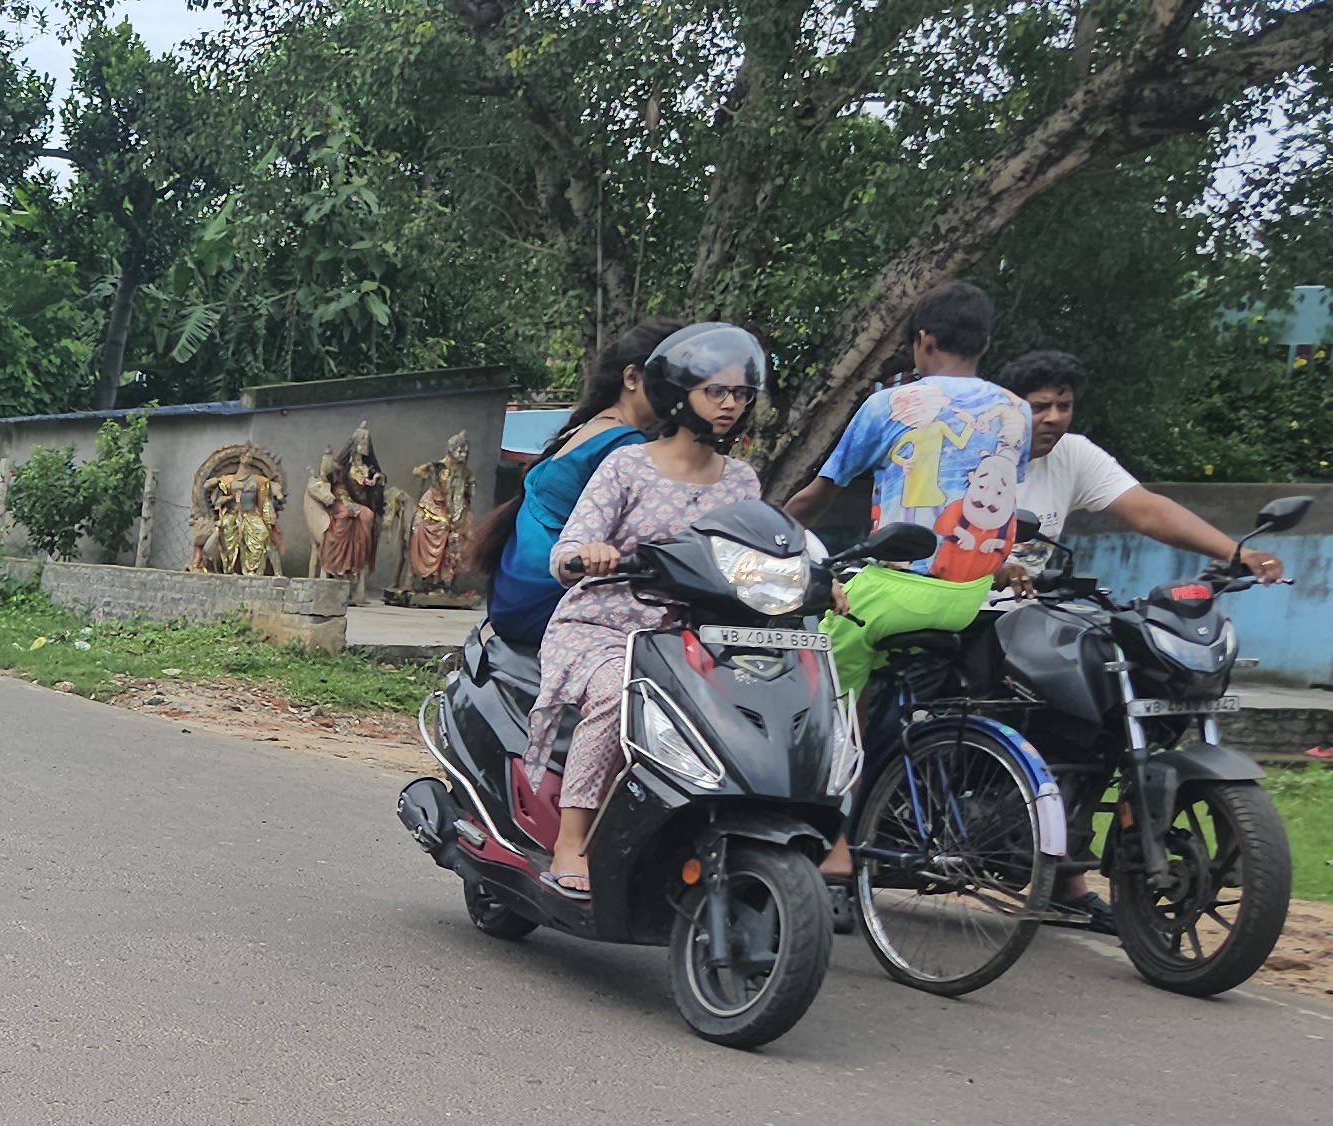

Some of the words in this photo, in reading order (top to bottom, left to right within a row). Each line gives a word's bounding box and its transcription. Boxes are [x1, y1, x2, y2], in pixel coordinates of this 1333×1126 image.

[720, 630, 739, 643] WB
[746, 632, 783, 647] 40AR
[791, 634, 828, 648] 6979
